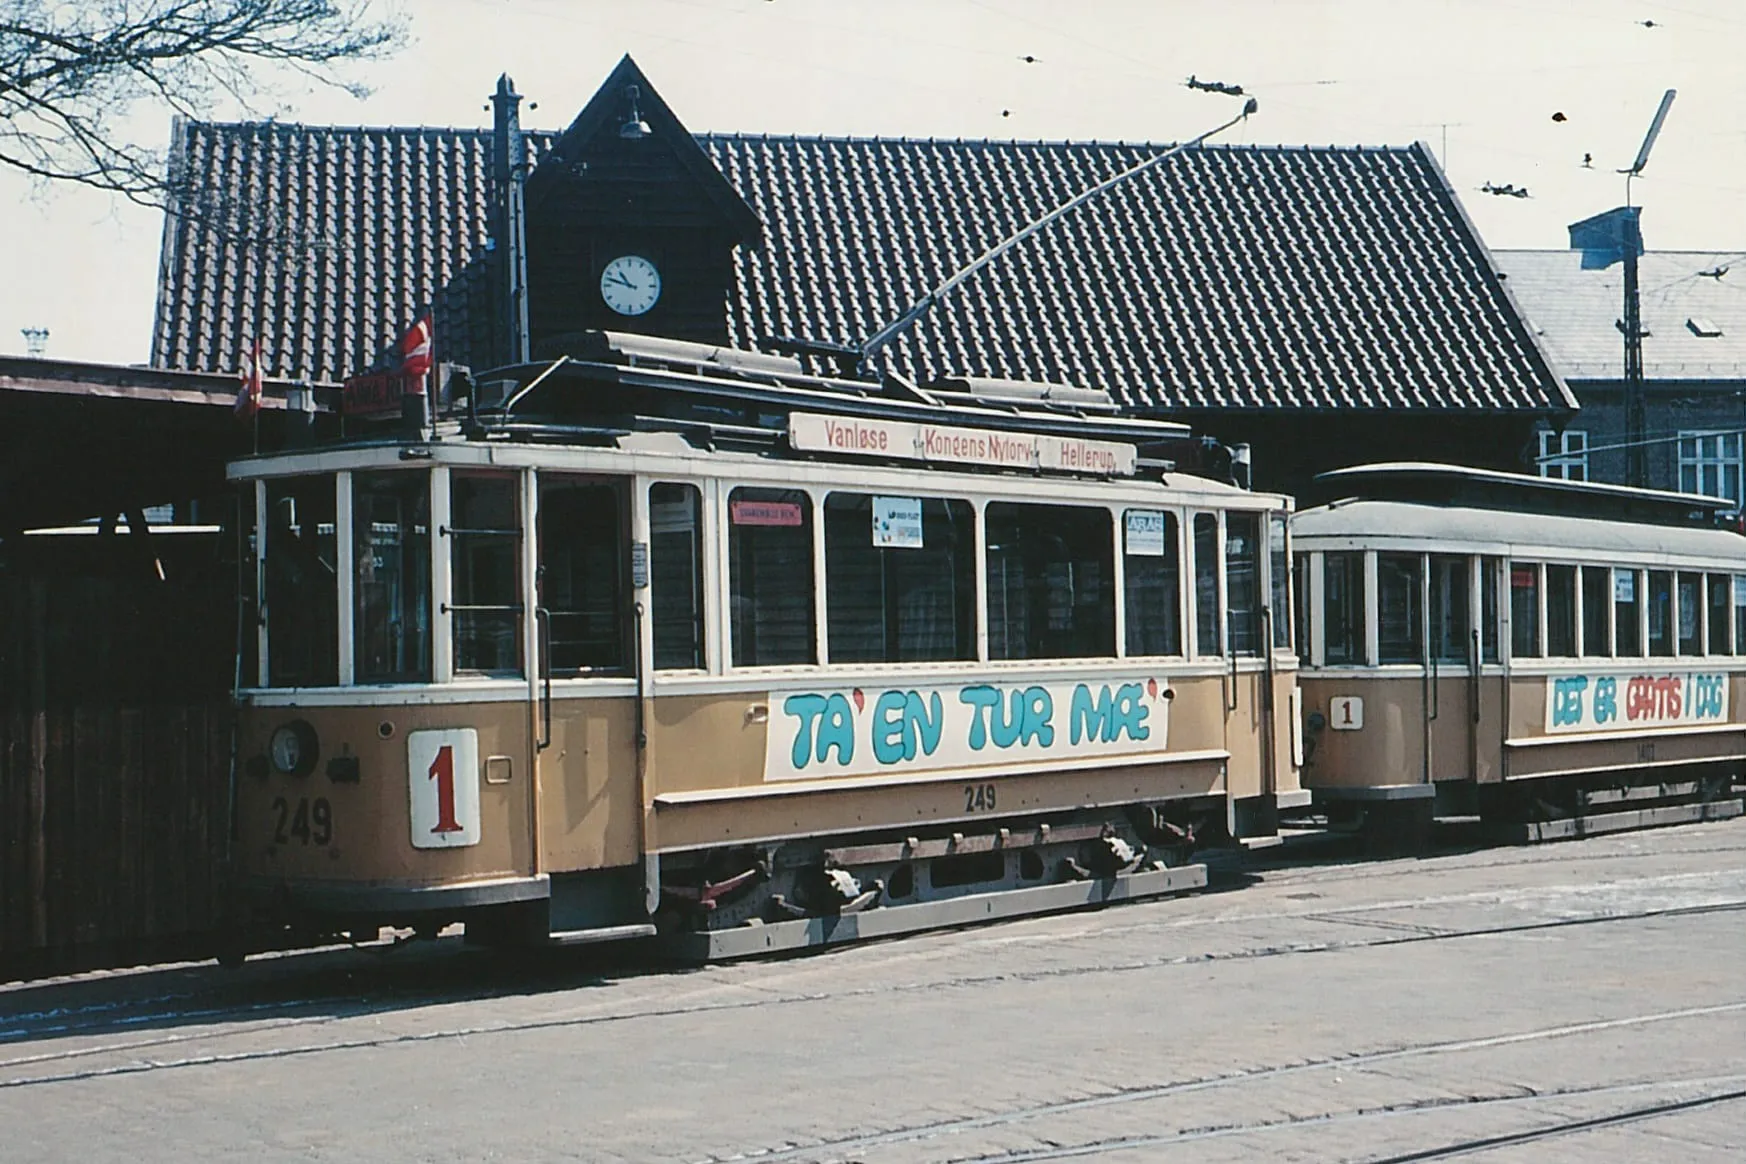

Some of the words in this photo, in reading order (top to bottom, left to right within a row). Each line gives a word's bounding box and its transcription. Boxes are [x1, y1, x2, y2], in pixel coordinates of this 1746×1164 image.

[824, 420, 888, 450] Vanløse
[925, 429, 985, 458] Kongens
[1060, 441, 1115, 471] Hellerup
[1342, 701, 1354, 724] 1
[1553, 674, 1589, 728] DET
[1593, 676, 1617, 724] ER
[1626, 673, 1682, 721] GRATIS
[1695, 675, 1724, 719] DAG
[784, 688, 865, 769] TA'
[872, 690, 943, 765] EN
[959, 685, 1055, 751] TUR
[428, 745, 464, 833] 1
[964, 783, 997, 813] 249
[271, 796, 332, 846] 249
